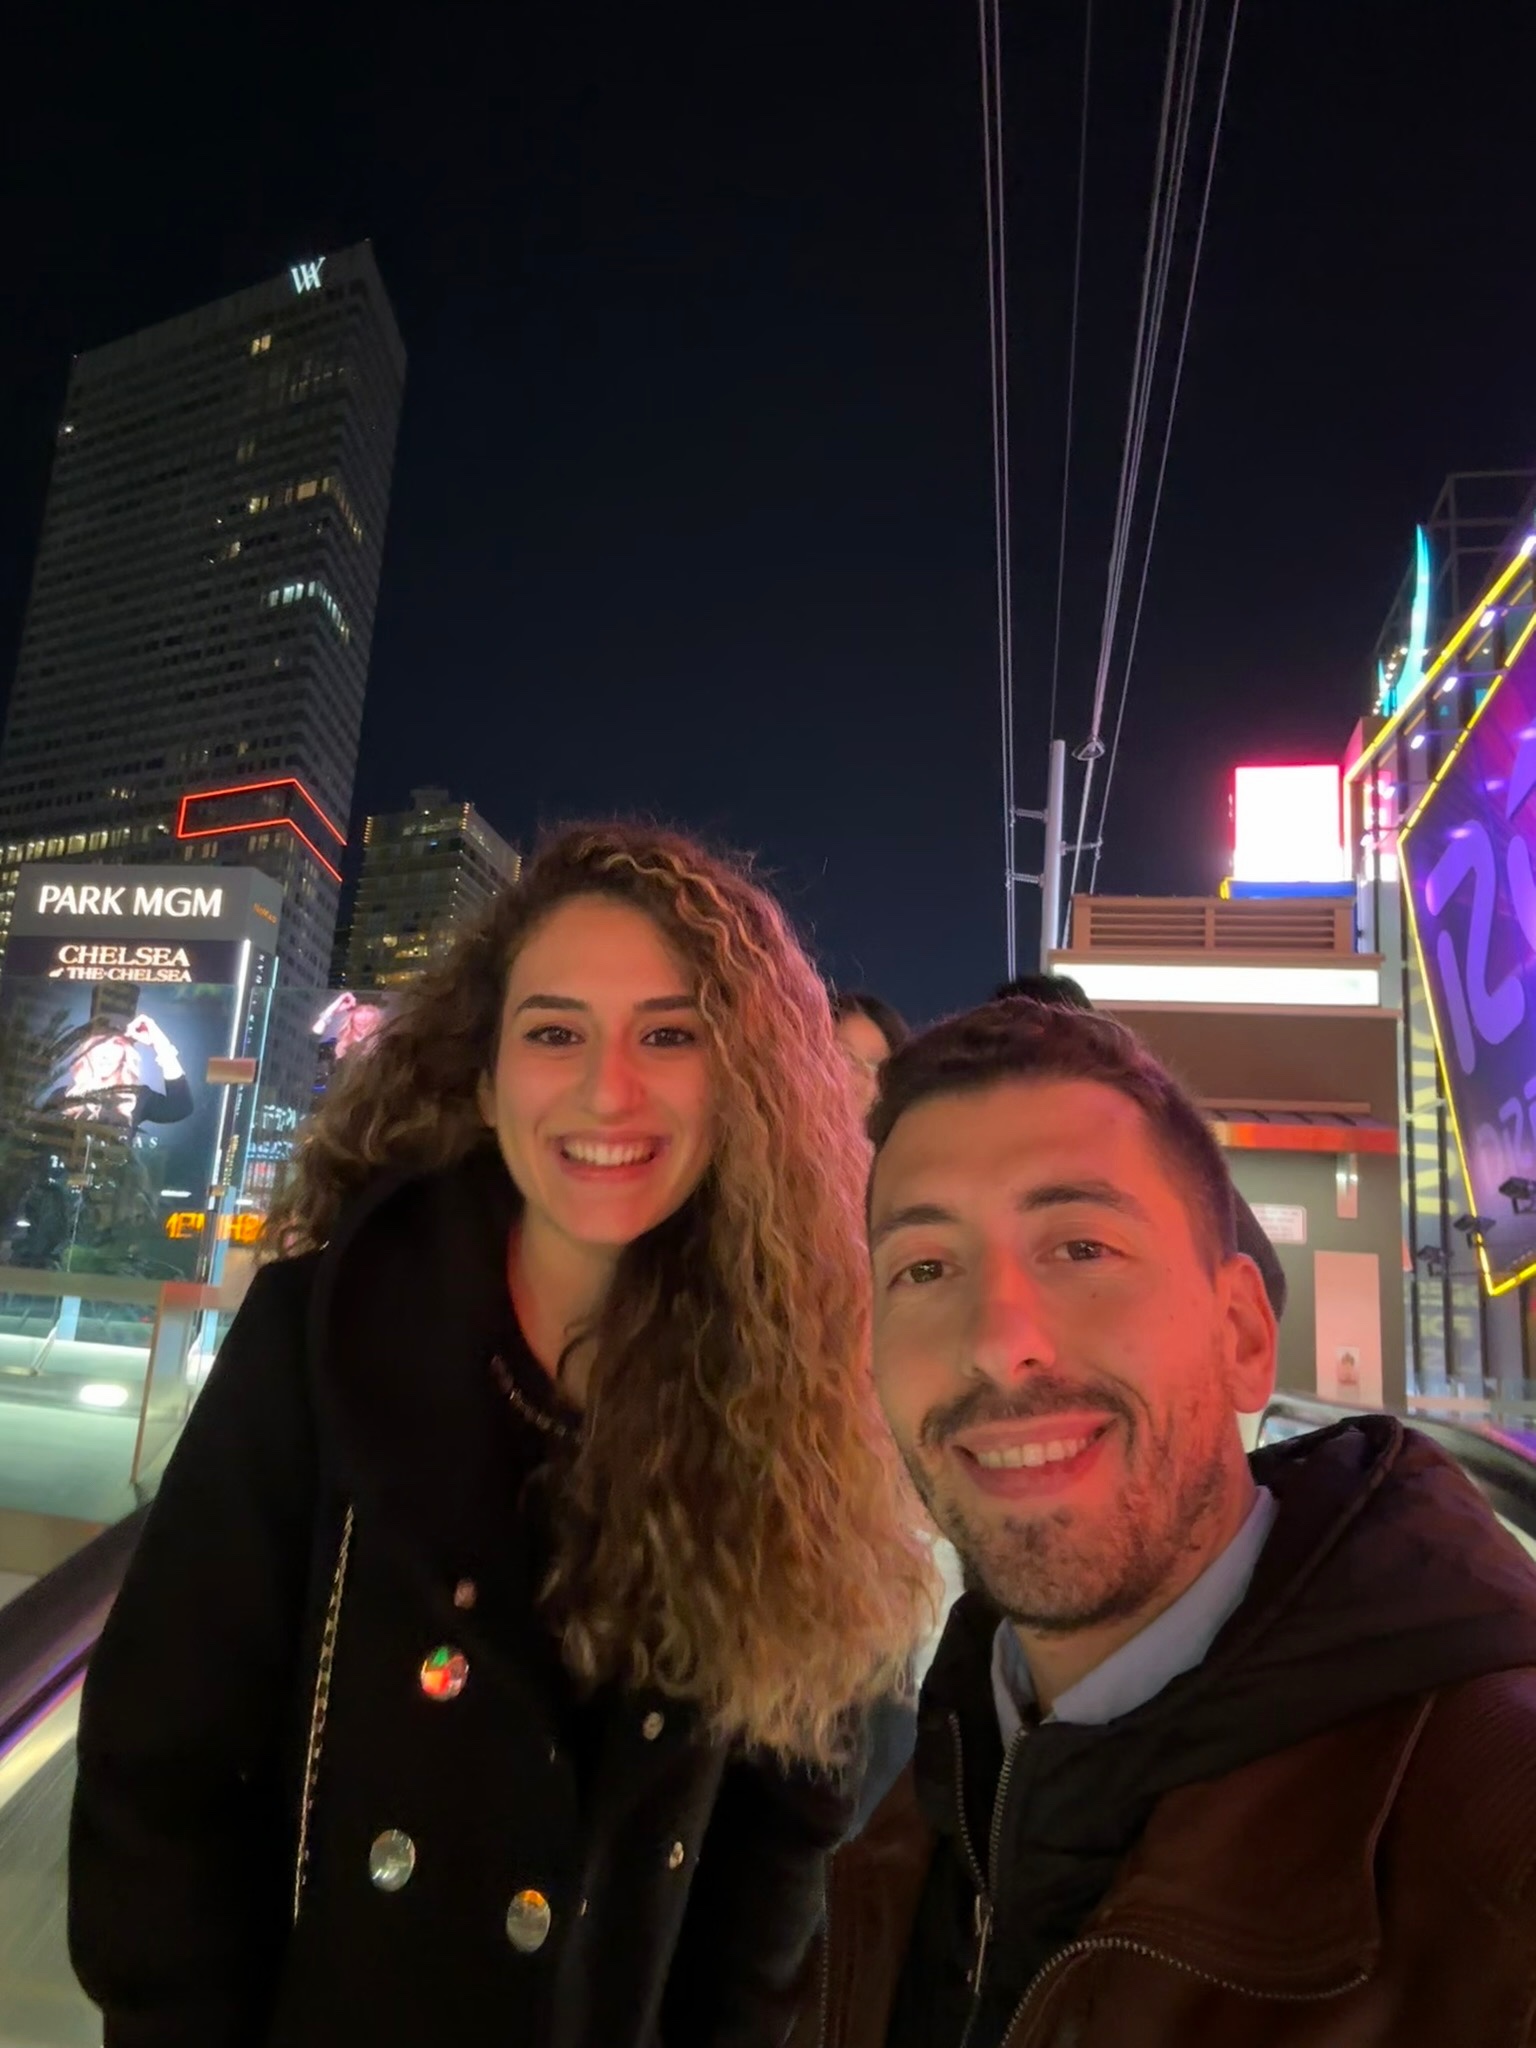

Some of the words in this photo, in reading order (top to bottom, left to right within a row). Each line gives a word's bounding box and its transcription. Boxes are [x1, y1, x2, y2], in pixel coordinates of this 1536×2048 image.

[38, 884, 126, 916] PARK
[132, 886, 223, 918] MGM
[58, 944, 191, 967] CHELSEA
[106, 967, 193, 983] CHELSEA
